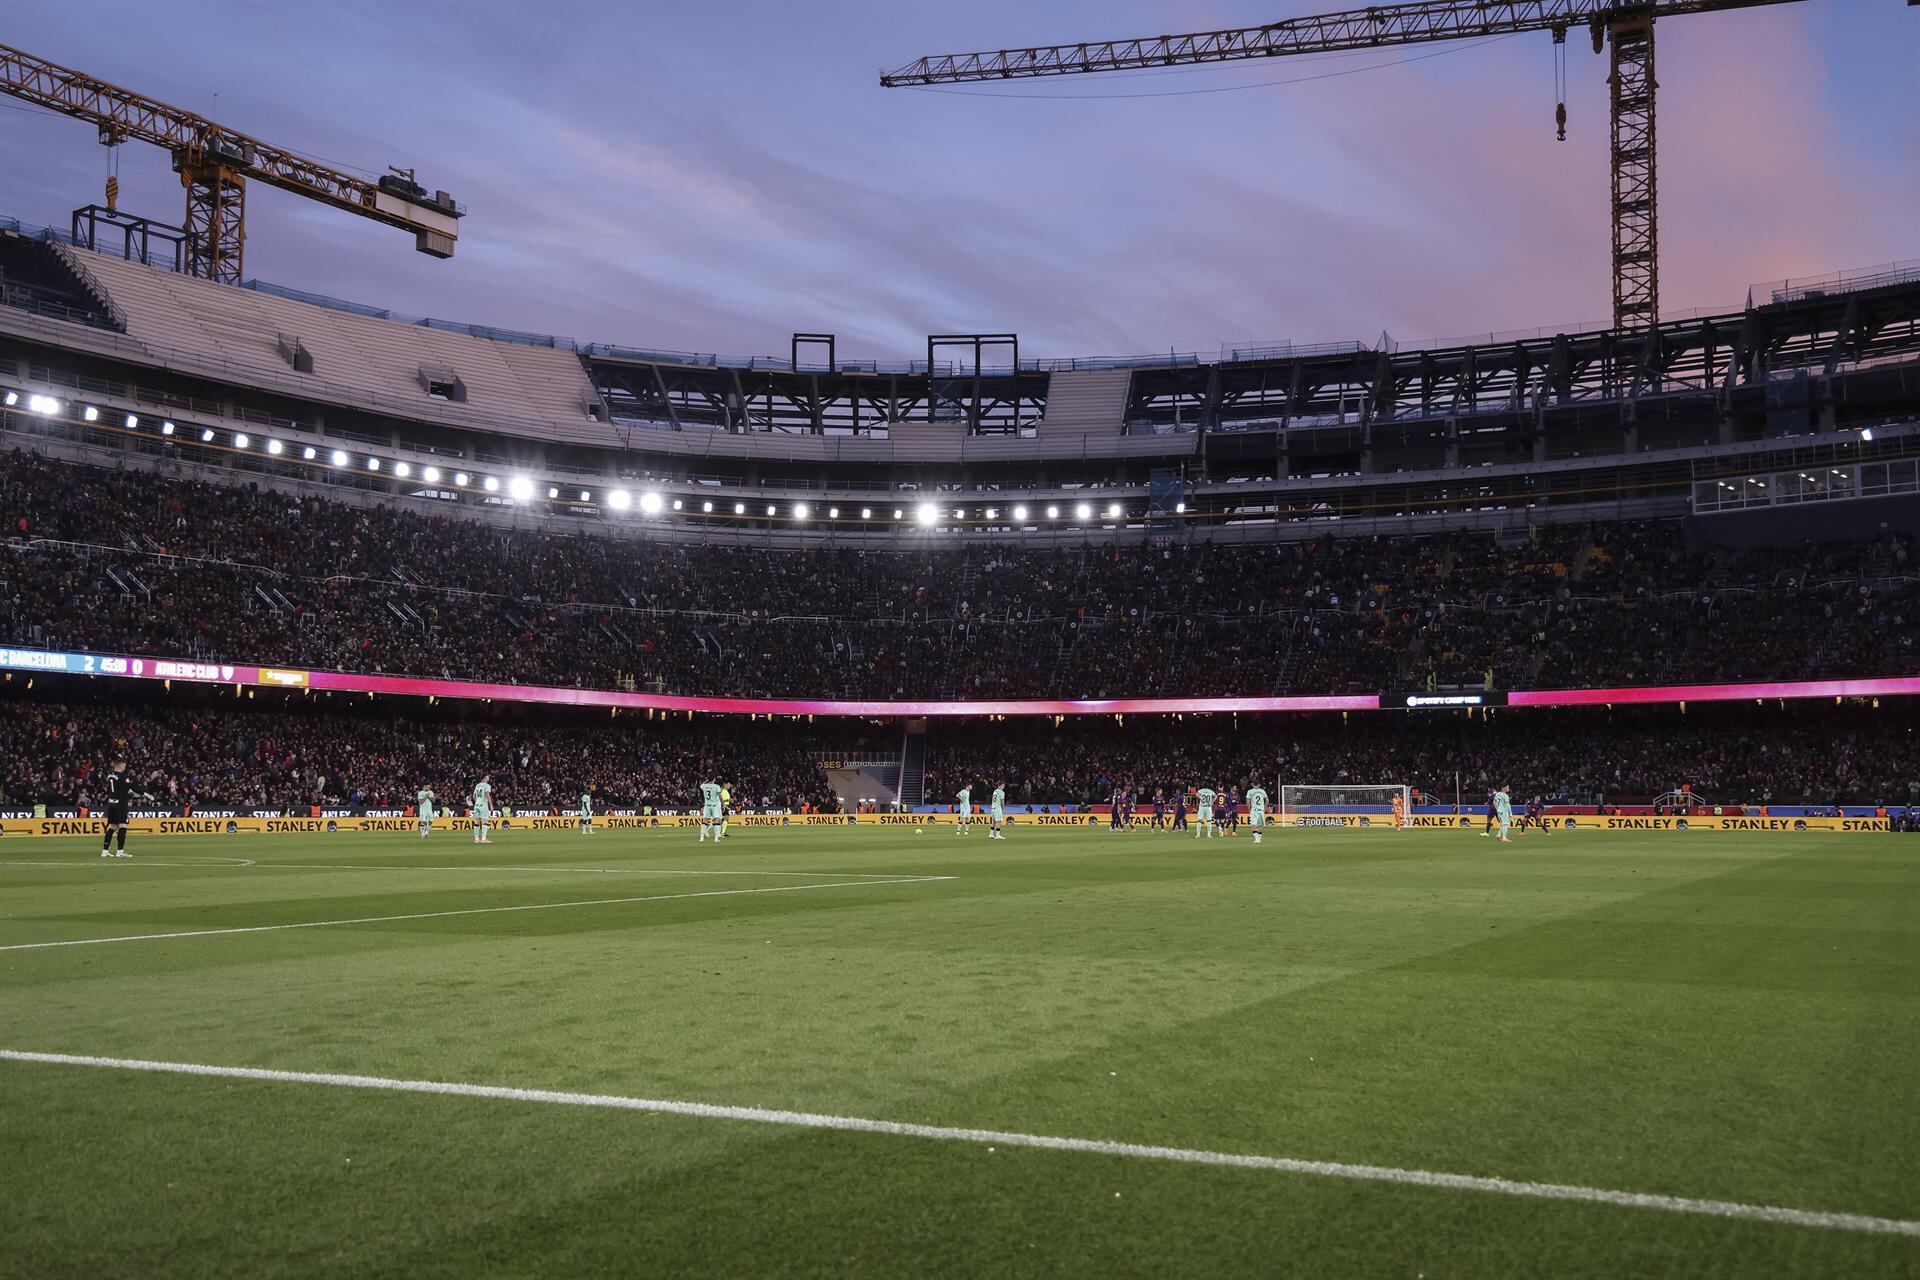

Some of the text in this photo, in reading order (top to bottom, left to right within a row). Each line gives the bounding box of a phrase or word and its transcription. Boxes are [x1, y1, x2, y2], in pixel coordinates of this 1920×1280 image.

[85, 656, 94, 672] 2
[132, 659, 143, 675] 0
[706, 790, 711, 800] 3
[1219, 796, 1224, 805] 9
[1256, 796, 1261, 805] 2
[363, 820, 414, 831] STANLEY
[533, 819, 575, 829] STANLEY
[608, 818, 648, 828] STANLEY
[745, 817, 780, 826] STANLEY
[807, 816, 844, 825] STANLEY
[880, 816, 924, 825] STANLEY
[1038, 816, 1084, 825] STANLEY
[1608, 819, 1671, 829] STANLEY
[1722, 819, 1789, 830] STANLEY
[42, 822, 109, 834] STANLEY
[160, 821, 222, 833] STANLEY
[267, 821, 323, 832] STANLEY
